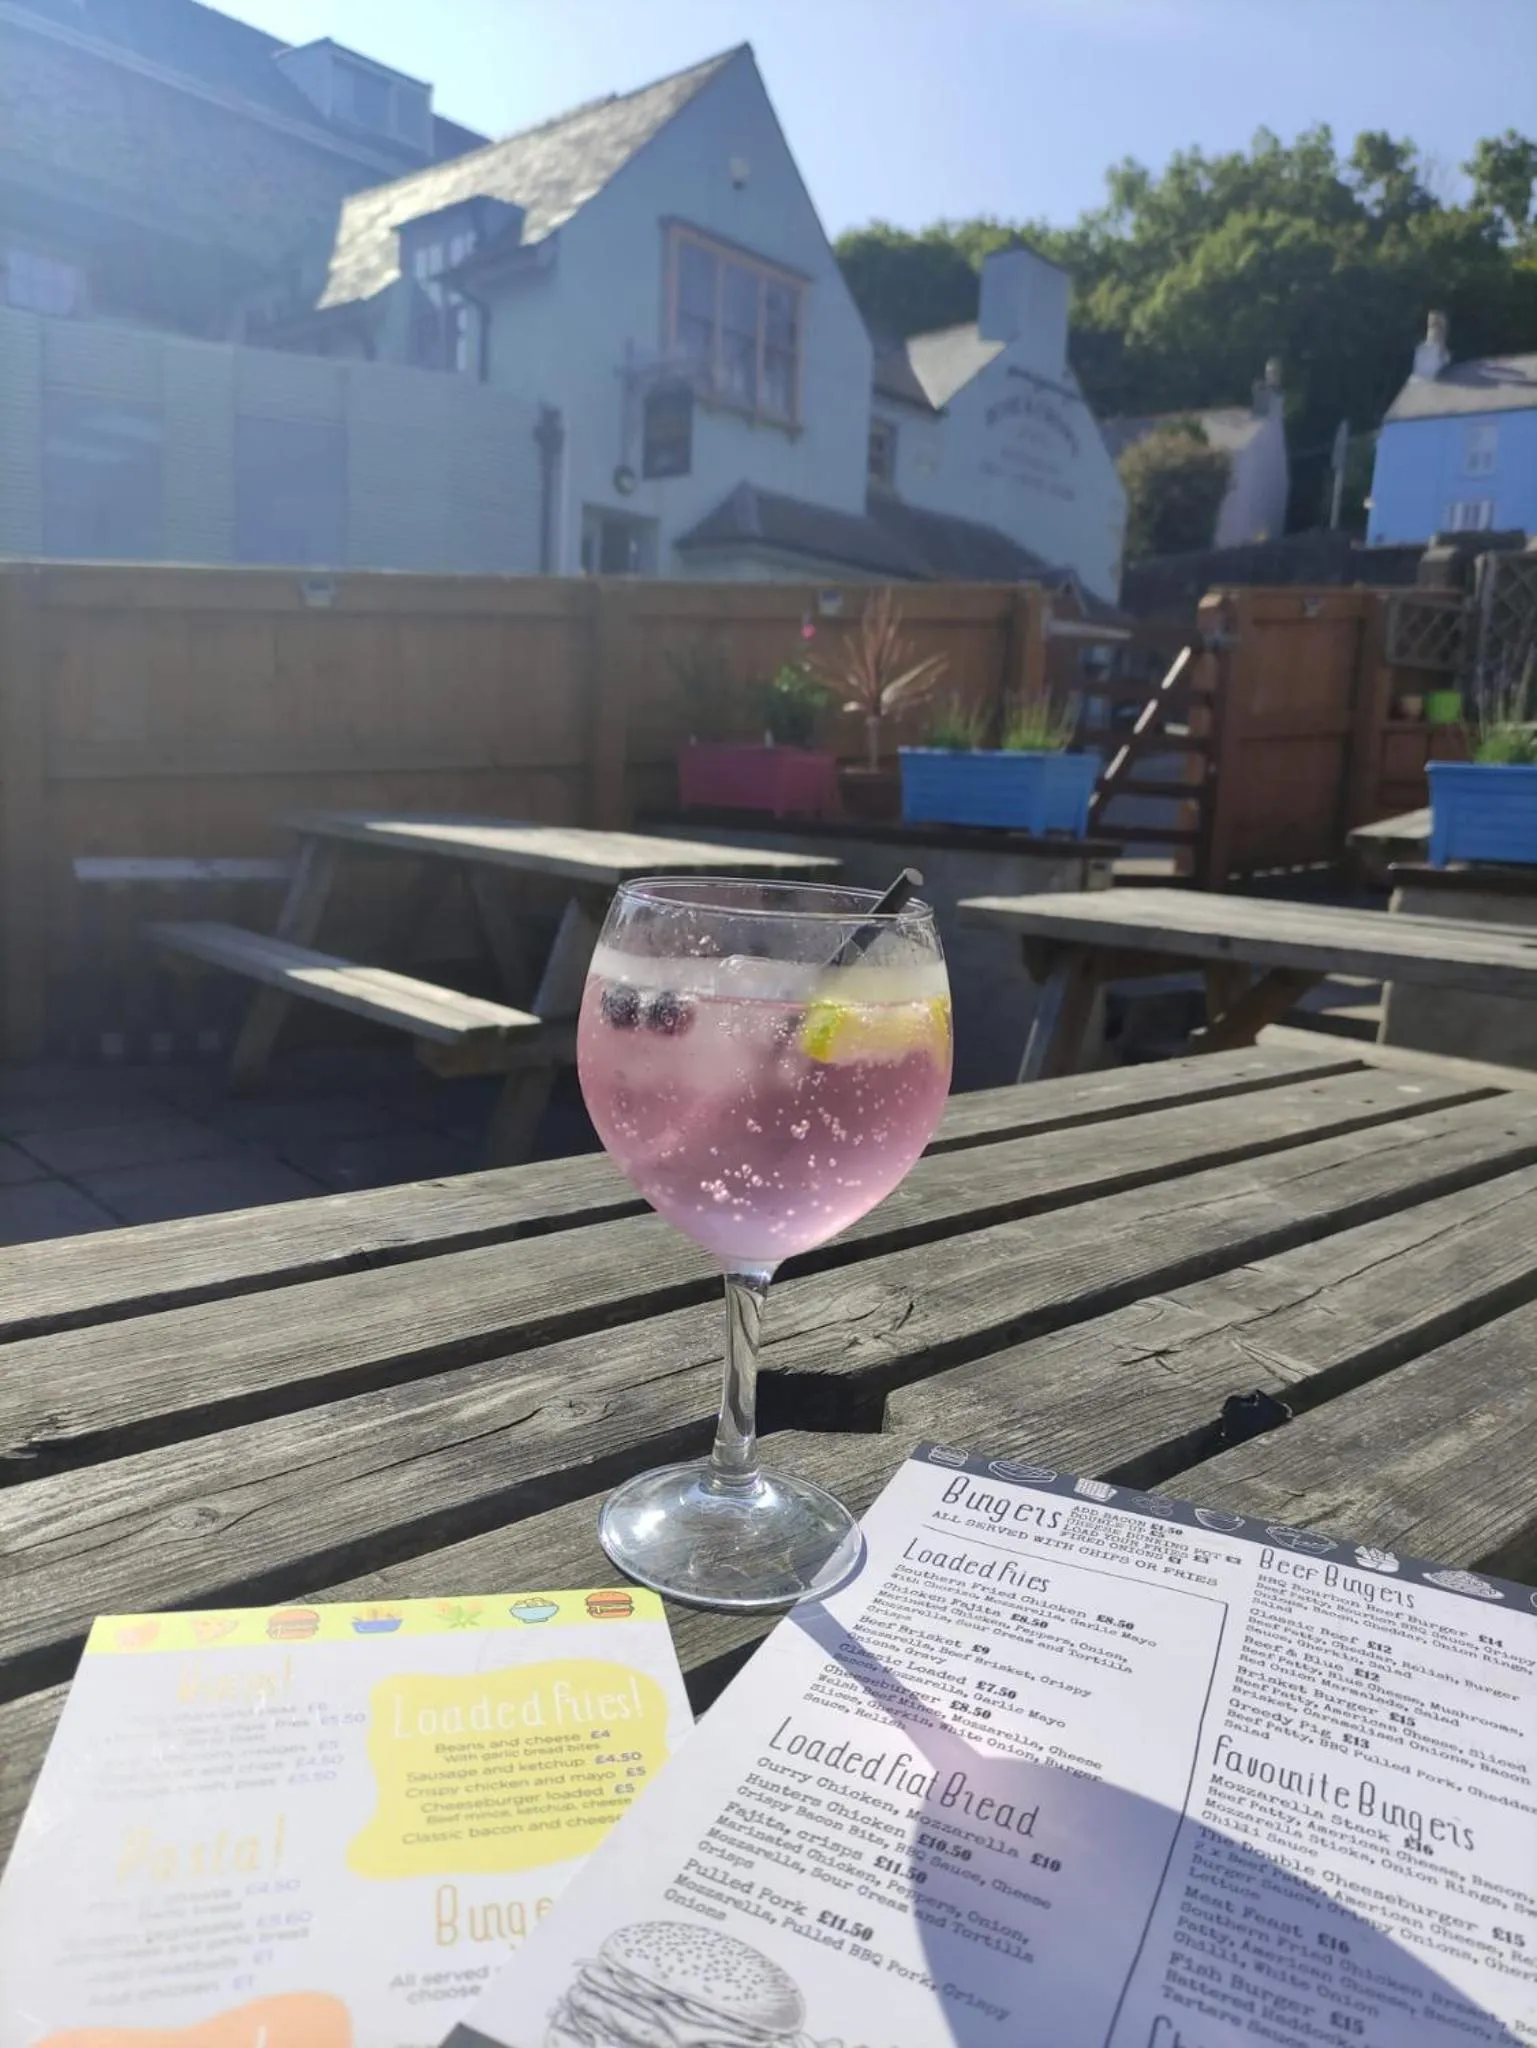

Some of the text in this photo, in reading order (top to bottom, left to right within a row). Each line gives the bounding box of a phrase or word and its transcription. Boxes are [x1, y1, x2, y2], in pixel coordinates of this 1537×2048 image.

[942, 1476, 1062, 1528] Burgers
[902, 1538, 1050, 1592] Loaded fries
[932, 1510, 1218, 1586] ALL SERVED WITH CHIPS OR FRIES
[1260, 1548, 1414, 1610] Beef Burgers
[878, 1590, 1128, 1664] Marinated Chicken, Peppers, Onion,
[884, 1582, 1048, 1628] Chicken Fajita £8.50
[894, 1564, 1134, 1630] Southern Fried Chicken £8.50
[1258, 1574, 1502, 1648] BBQ Bourbon Beef Burger £14
[858, 1614, 990, 1654] Beef Brisket £9
[1244, 1634, 1380, 1682] Beef & Blue £12
[1250, 1608, 1392, 1654] Classic Beef £12
[824, 1664, 992, 1720] Cheeseburger £8.50
[840, 1644, 1016, 1700] Classic Loaded £7.50
[1238, 1664, 1416, 1726] Brisket Burger £15
[392, 1675, 643, 1739] Loaded fries!
[802, 1692, 908, 1732] Sauce, Relish
[818, 1674, 858, 1692] Welsh
[862, 1686, 896, 1702] Beef
[950, 1714, 1044, 1752] Mozzarella,
[1048, 1746, 1102, 1770] Cheese
[972, 1692, 1024, 1714] Garlic
[1028, 1710, 1066, 1728] Mayo
[1228, 1698, 1370, 1750] Greedy Pig £13
[406, 1750, 643, 1783] Sausage and ketchup £4.50
[435, 1729, 611, 1754] Beans and cheese £4
[482, 1748, 519, 1762] garlic
[524, 1744, 563, 1757] bread
[567, 1741, 600, 1752] bites
[940, 1720, 984, 1742] White
[986, 1738, 1040, 1764] Onion,
[1042, 1756, 1102, 1784] Burger
[405, 1766, 647, 1800] Crispy chicken and mayo £5
[420, 1782, 636, 1814] Cheeseburger loaded £5
[768, 1716, 886, 1782] Loaded
[940, 1772, 1040, 1838] Bread
[1210, 1774, 1324, 1820] Mozzarella
[1330, 1814, 1390, 1842] Stack
[1212, 1734, 1474, 1852] Favourite Burgers
[402, 1824, 464, 1846] Classic
[468, 1822, 524, 1838] bacon
[529, 1818, 561, 1832] and
[724, 1802, 926, 1884] Fajita, crisps £11.50
[744, 1772, 972, 1862] Hunters Chicken £10.50
[758, 1756, 1062, 1872] Curry Chicken, Mozzarella £10
[698, 1840, 754, 1870] Crisps
[736, 1786, 1052, 1910] Crispy Bacon Bits, BBQ Sauce, Cheese
[664, 1888, 728, 1920] Onions
[682, 1858, 874, 1942] Pulled Pork £11.50
[706, 1826, 1034, 1964] Mozzarella, Sour Cream and Tortilla
[714, 1814, 1030, 1946] Marinated Chicken, Peppers, Onion,
[1198, 1824, 1526, 1948] The Double Cheeseburger £15
[674, 1872, 1010, 2022] Mozzarella, Pulled BBQ Pork, Crispy
[1184, 1884, 1350, 1954] Meat Feast £16
[406, 1984, 481, 2005] choose
[422, 1966, 489, 1987] served
[1168, 1950, 1364, 2036] Fish Burger £15
